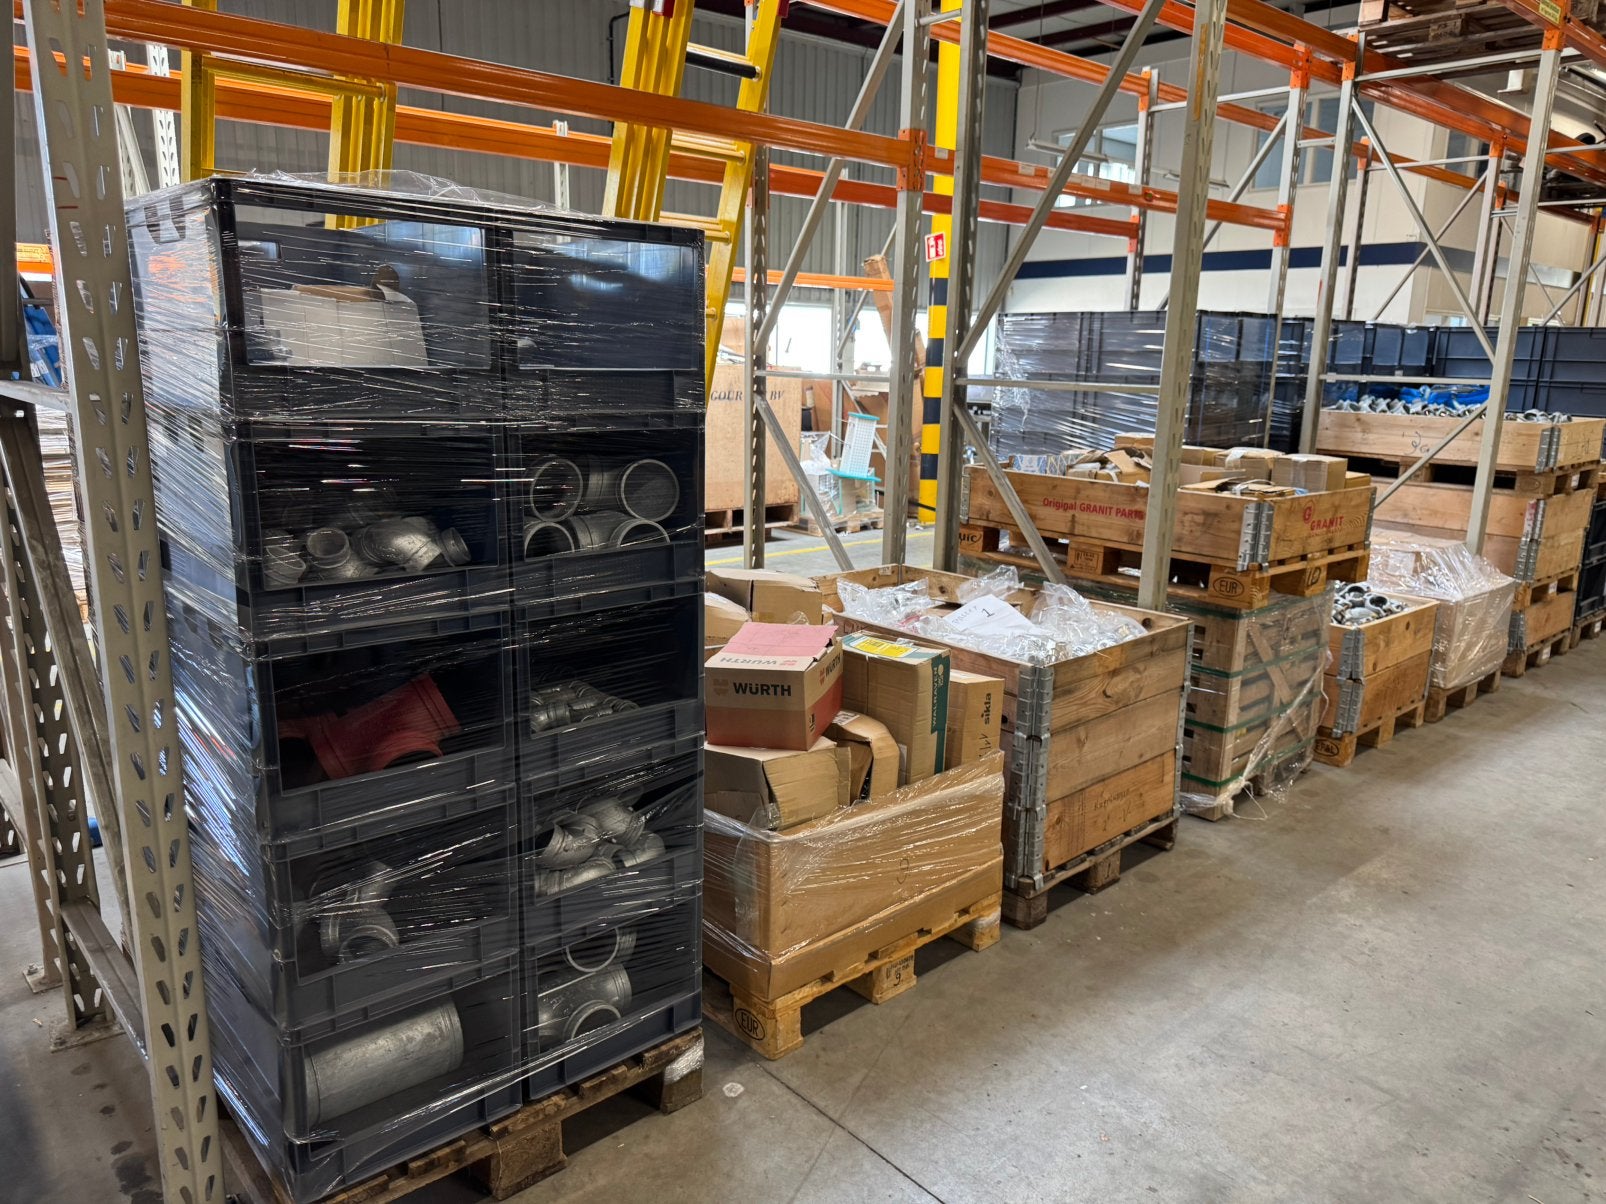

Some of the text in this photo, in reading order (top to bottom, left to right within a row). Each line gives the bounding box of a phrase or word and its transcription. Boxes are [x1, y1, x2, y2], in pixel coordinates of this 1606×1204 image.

[1042, 497, 1146, 520] Original GRANIT PARTS
[1310, 516, 1344, 531] GRANIT
[1219, 581, 1238, 594] EUR
[982, 608, 995, 618] 1
[981, 692, 992, 725] sikla
[741, 1012, 758, 1037] EUR
